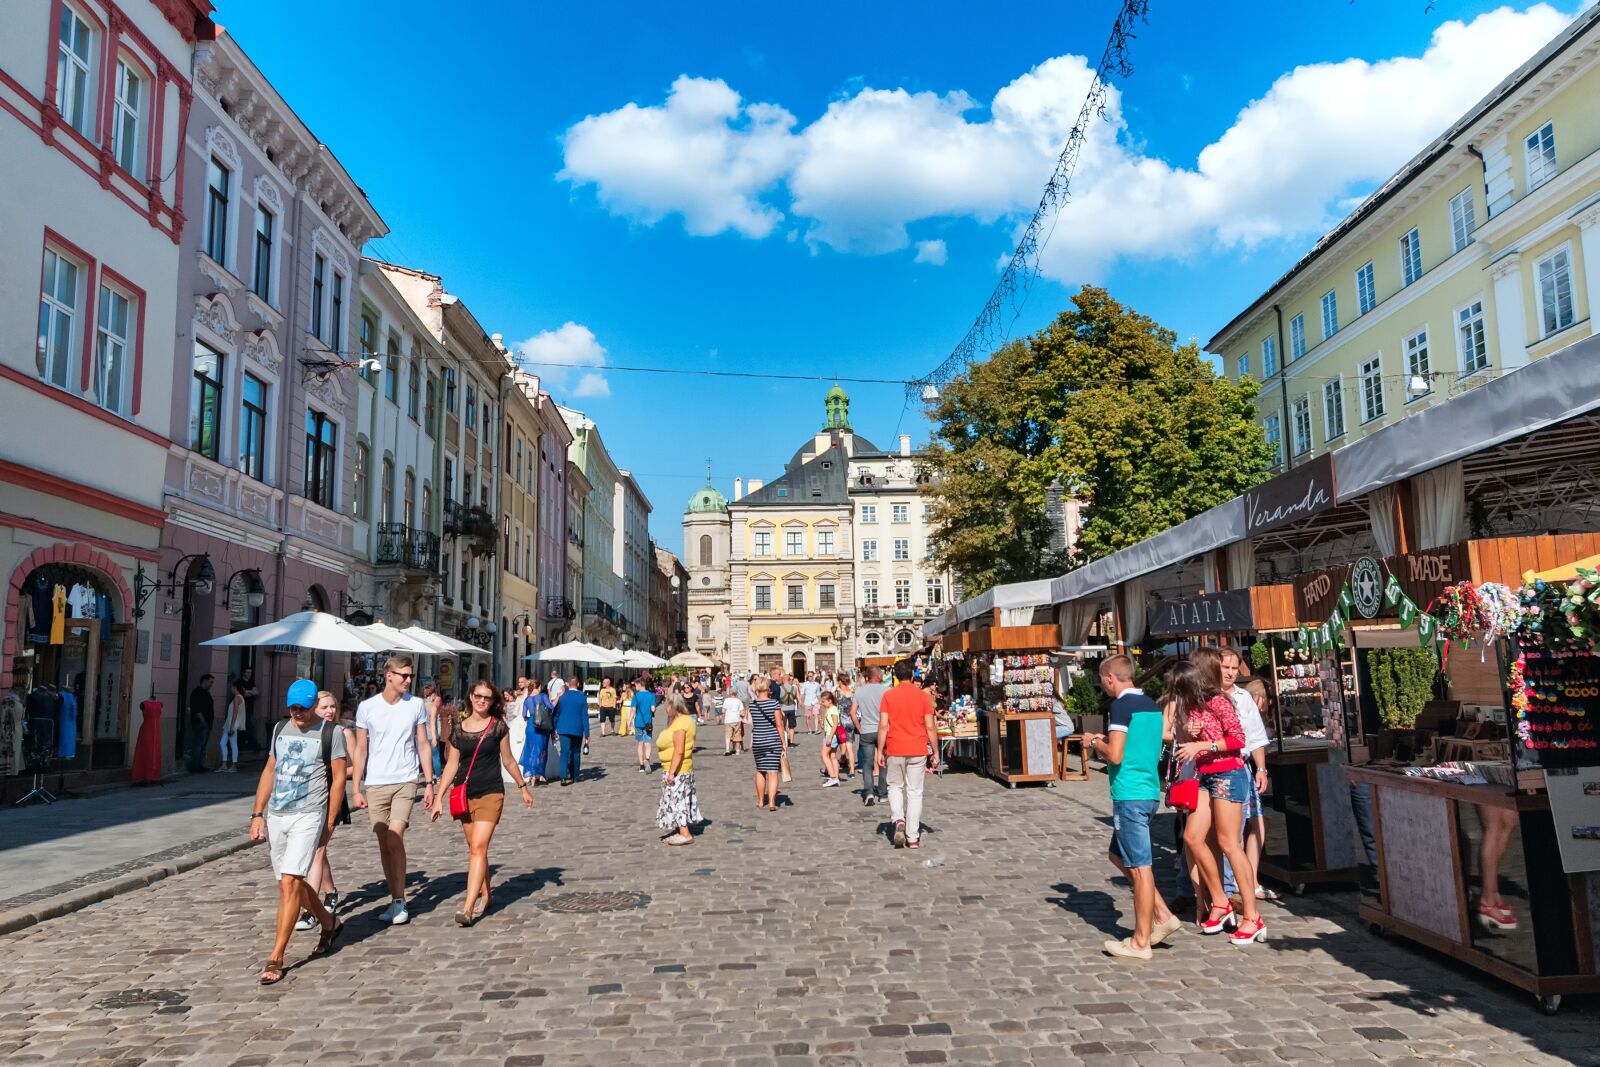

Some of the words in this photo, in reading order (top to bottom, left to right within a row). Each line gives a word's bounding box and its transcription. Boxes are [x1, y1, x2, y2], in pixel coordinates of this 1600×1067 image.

[1246, 478, 1330, 530] Veranda
[1303, 574, 1331, 607] HAND
[1408, 555, 1452, 582] MADE
